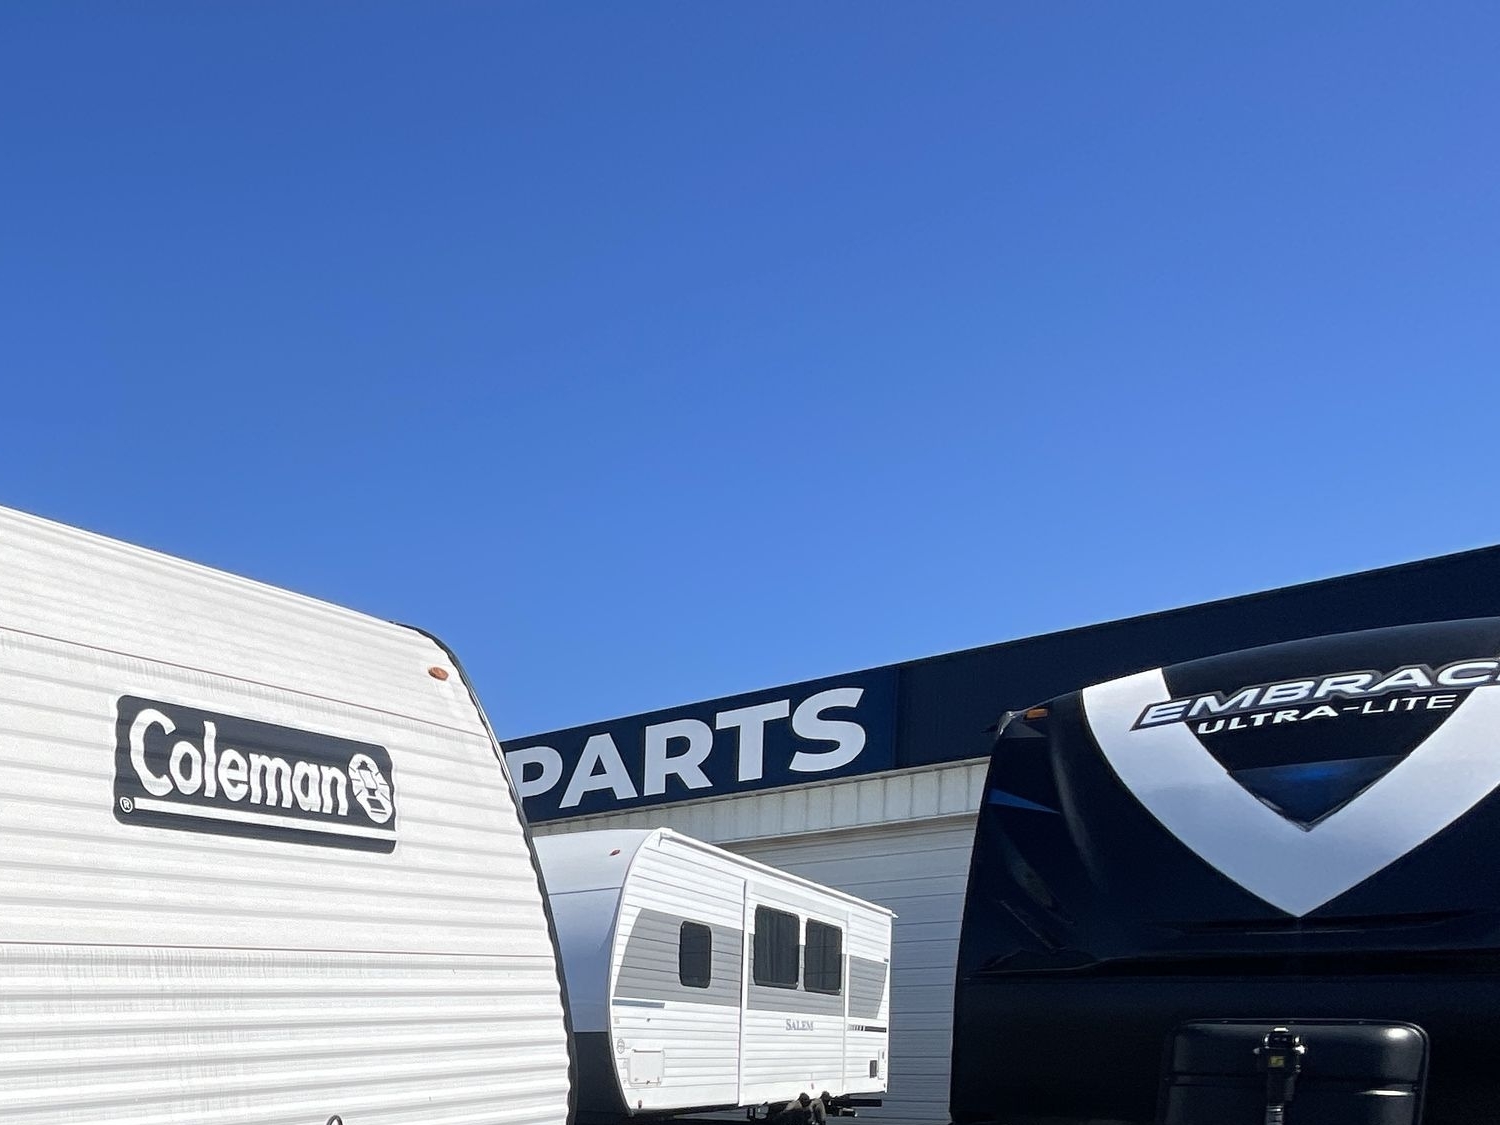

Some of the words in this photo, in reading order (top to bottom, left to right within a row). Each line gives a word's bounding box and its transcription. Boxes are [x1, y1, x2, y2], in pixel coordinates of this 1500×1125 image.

[1139, 661, 1500, 725] EMBRAC
[1197, 694, 1458, 735] ULTRA-LITE
[129, 708, 349, 816] Coleman
[504, 687, 867, 809] PARTS
[785, 1018, 814, 1031] SALEM
